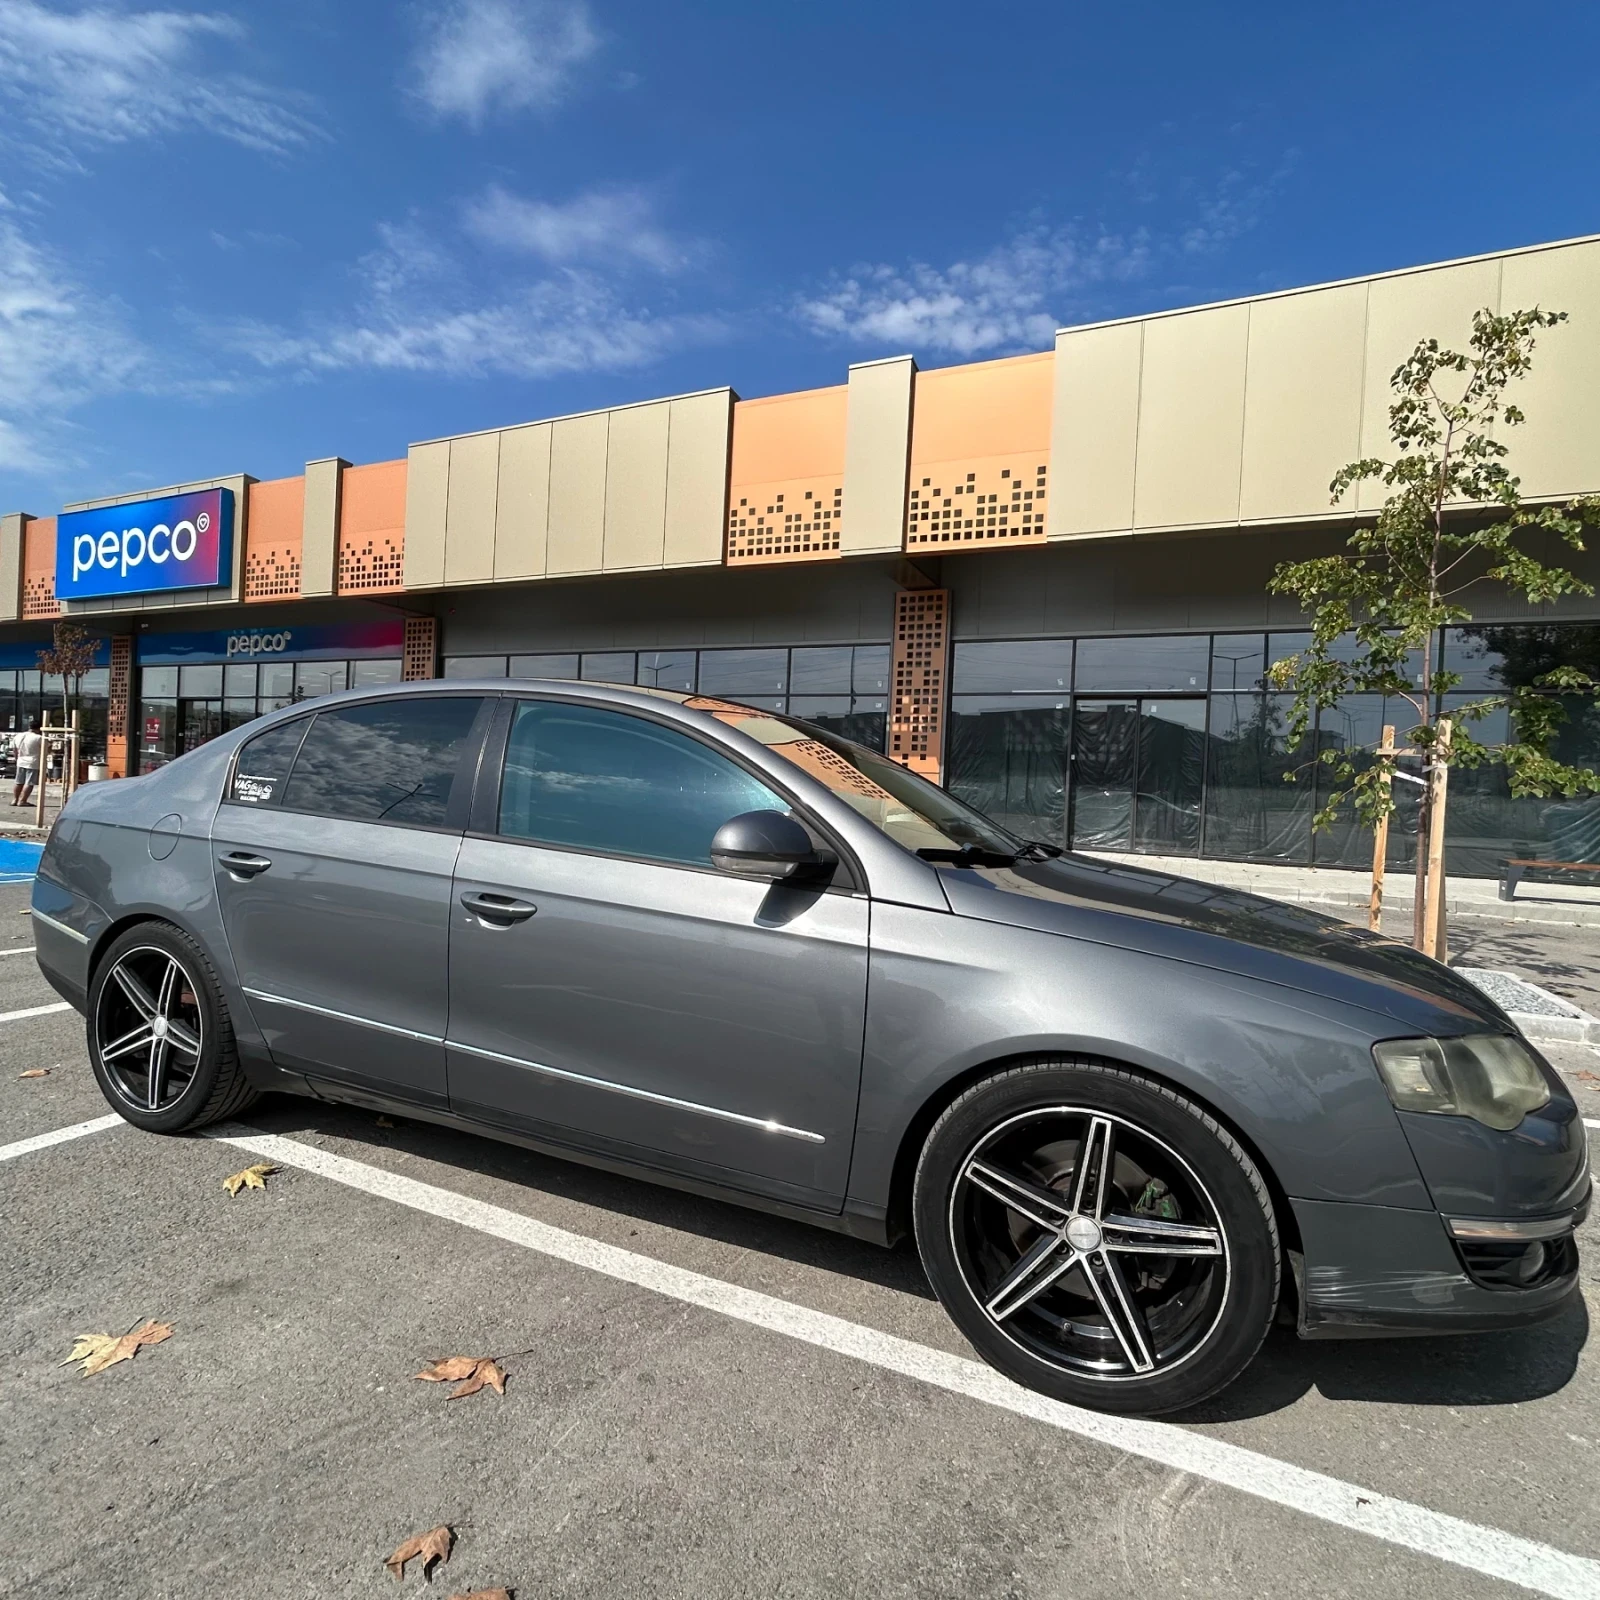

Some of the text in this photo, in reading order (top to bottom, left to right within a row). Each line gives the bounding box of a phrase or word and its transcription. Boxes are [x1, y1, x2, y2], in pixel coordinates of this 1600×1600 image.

[72, 520, 197, 582] pepco
[226, 633, 286, 657] pepco
[234, 779, 252, 790] VAG
